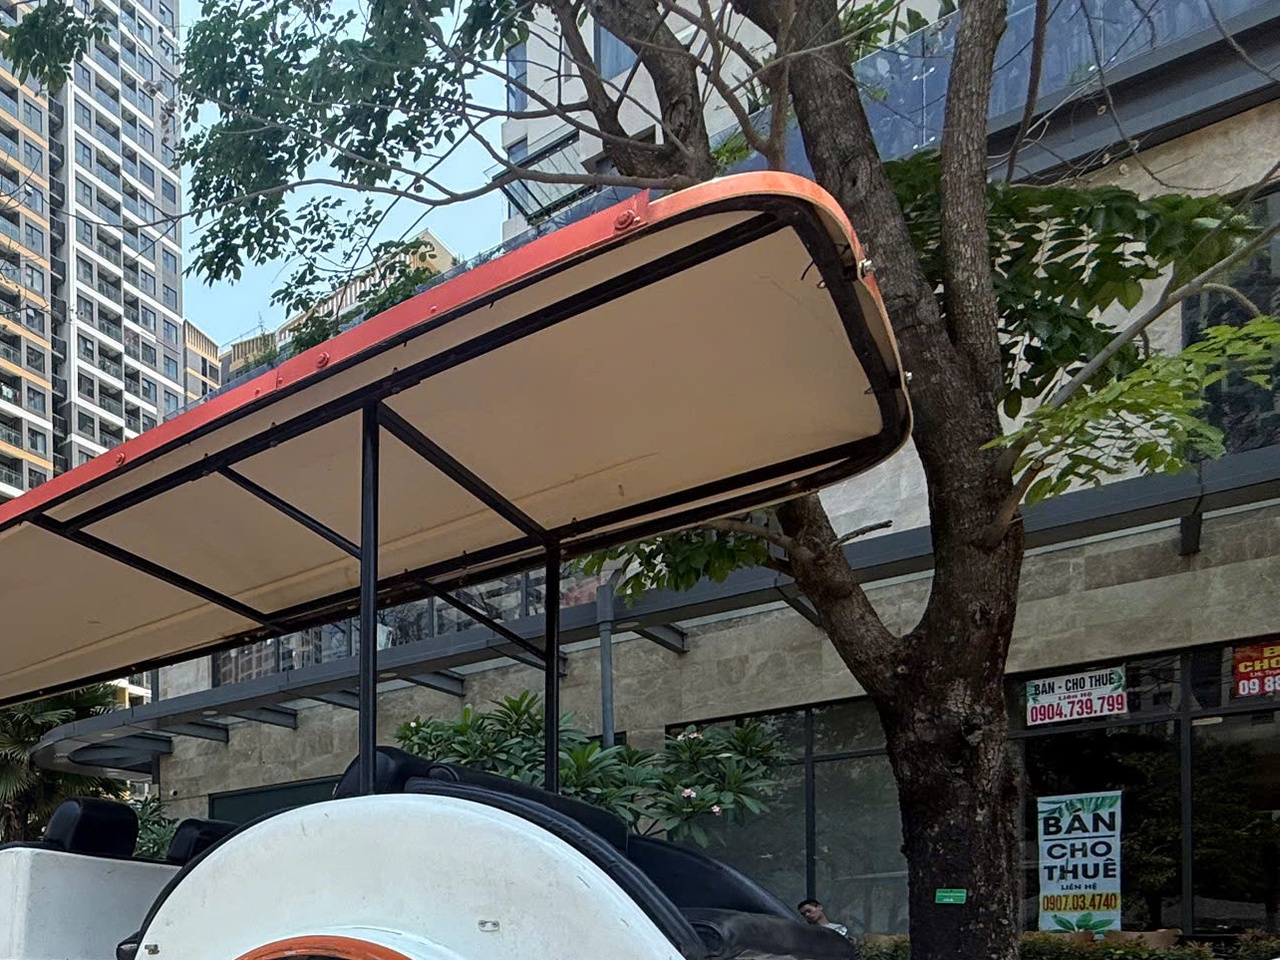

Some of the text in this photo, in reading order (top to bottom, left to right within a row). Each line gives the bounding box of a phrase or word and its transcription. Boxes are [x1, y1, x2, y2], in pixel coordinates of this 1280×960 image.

[1033, 679, 1055, 696] BÁN
[1065, 677, 1086, 691] CHO
[1088, 669, 1115, 687] THUÊ
[1238, 678, 1259, 695] 09
[1030, 693, 1124, 723] 0904.739.799
[1043, 808, 1116, 836] BÁN
[1047, 841, 1112, 859] CHO
[1043, 858, 1117, 881] THUÊ
[1061, 883, 1081, 891] LIÊN
[1043, 893, 1117, 911] 0907.03.4740
